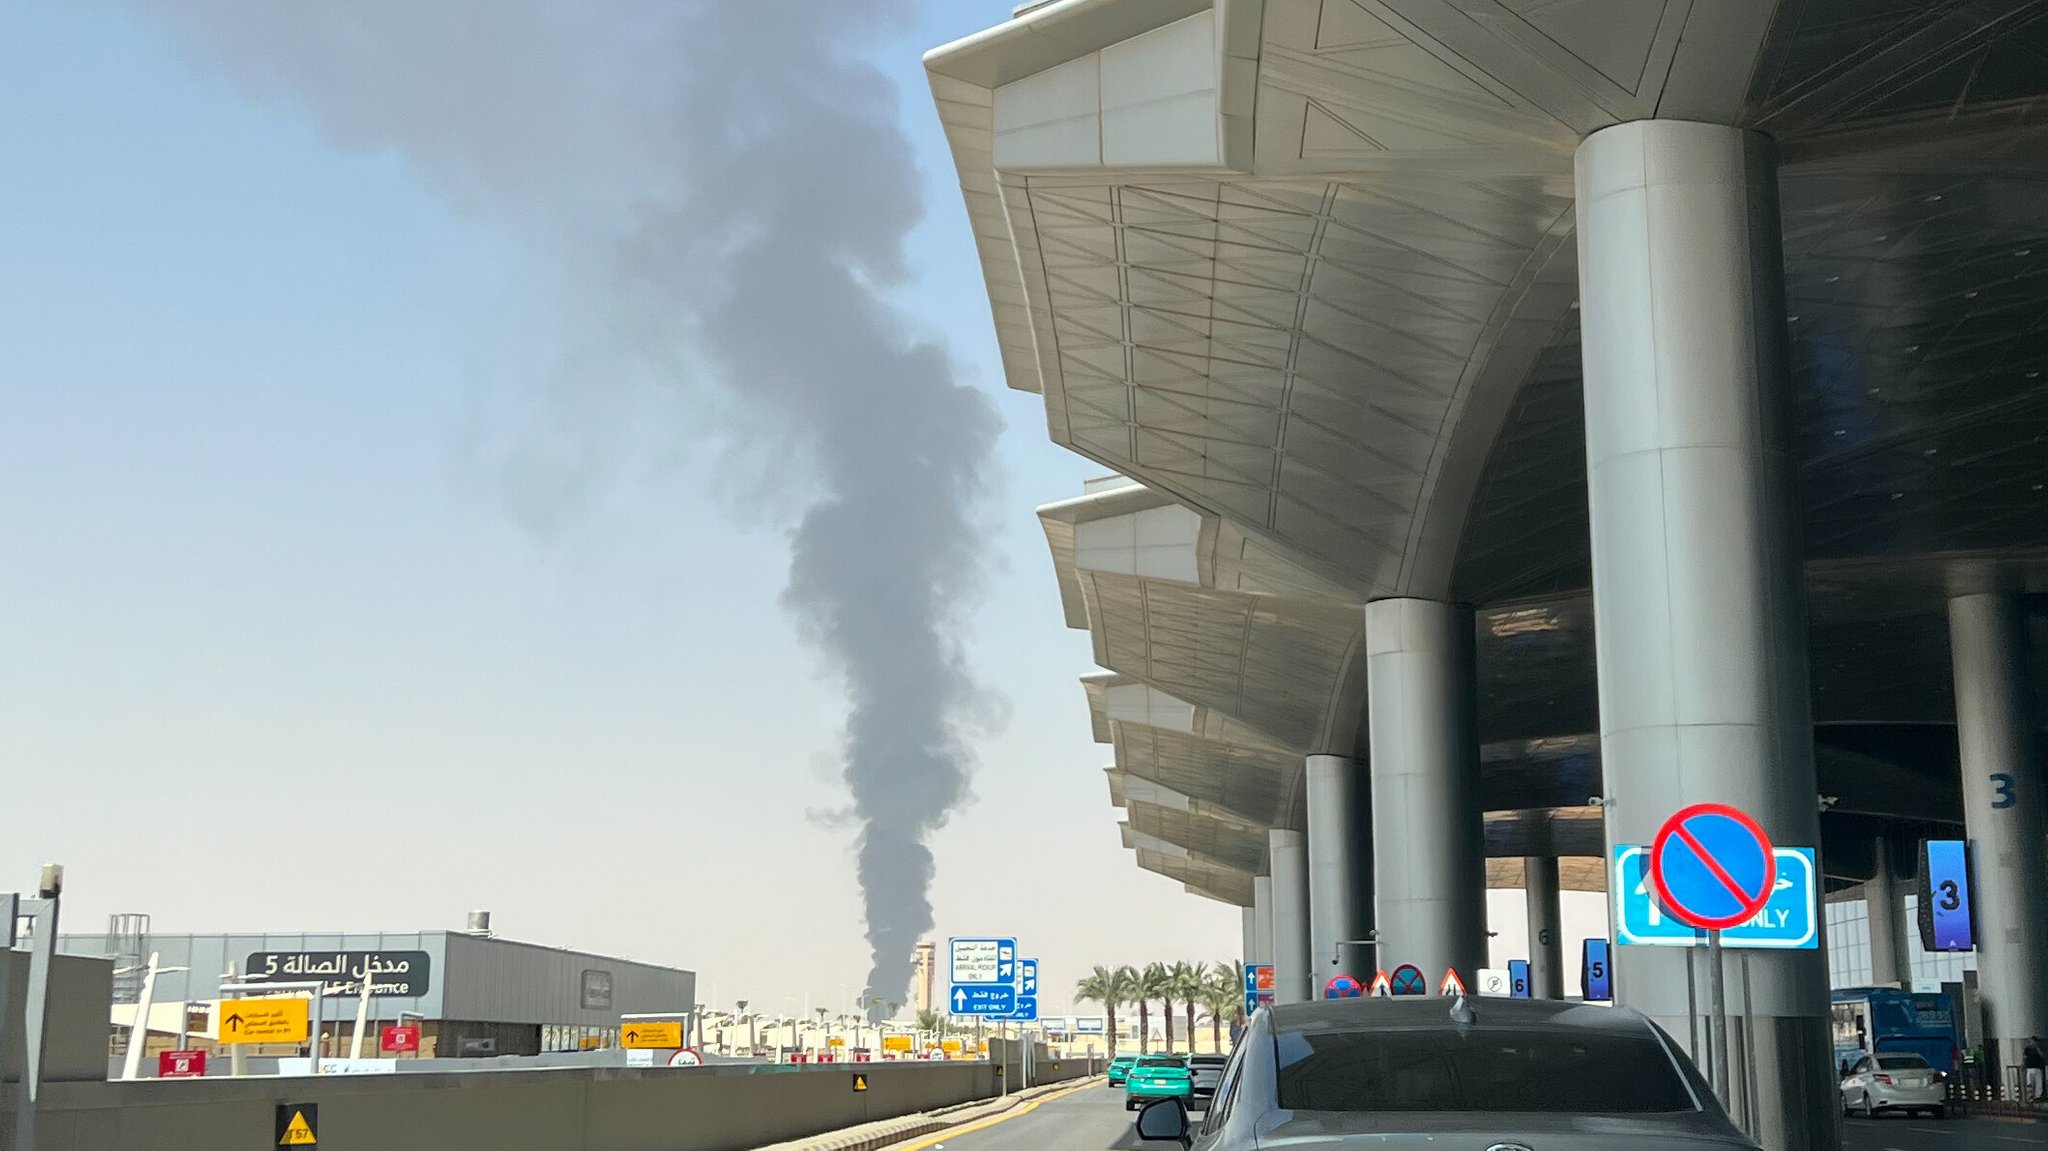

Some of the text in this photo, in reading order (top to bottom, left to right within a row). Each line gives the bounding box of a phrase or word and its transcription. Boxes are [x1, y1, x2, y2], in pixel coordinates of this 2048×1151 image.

[1989, 773, 2017, 809] 3
[1940, 879, 1960, 911] 3
[1741, 908, 1790, 928] NLY
[265, 954, 410, 979] مدخل الصالة 5
[1592, 962, 1604, 978] 5
[345, 981, 409, 994] Enance
[1515, 979, 1524, 992] 6
